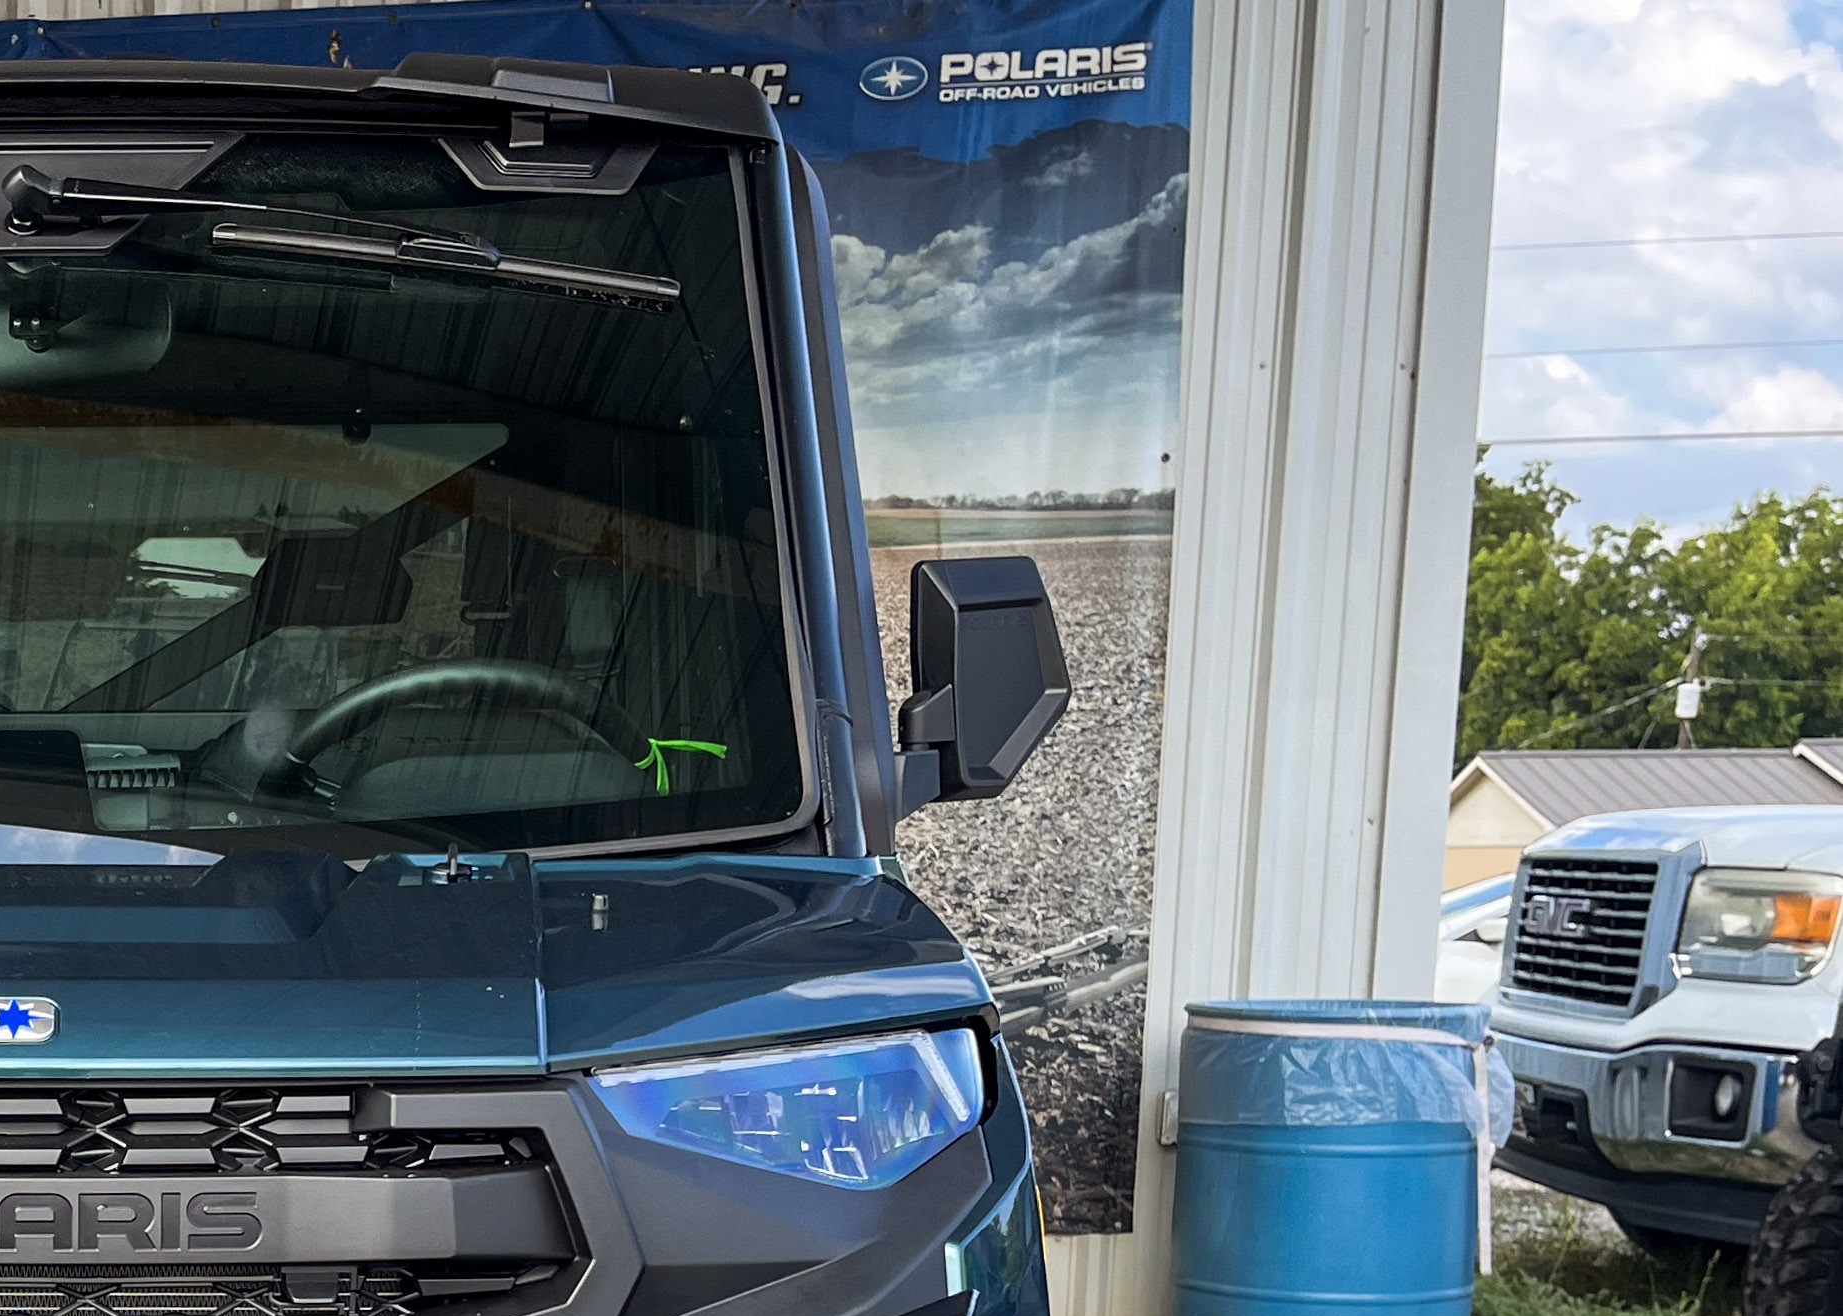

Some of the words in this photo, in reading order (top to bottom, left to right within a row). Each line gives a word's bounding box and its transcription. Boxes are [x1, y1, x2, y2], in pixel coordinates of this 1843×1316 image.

[940, 42, 1148, 83] POLARIS
[939, 85, 1041, 103] OFF-ROAD
[1046, 76, 1146, 98] VEHICLES
[1524, 894, 1591, 938] GMC
